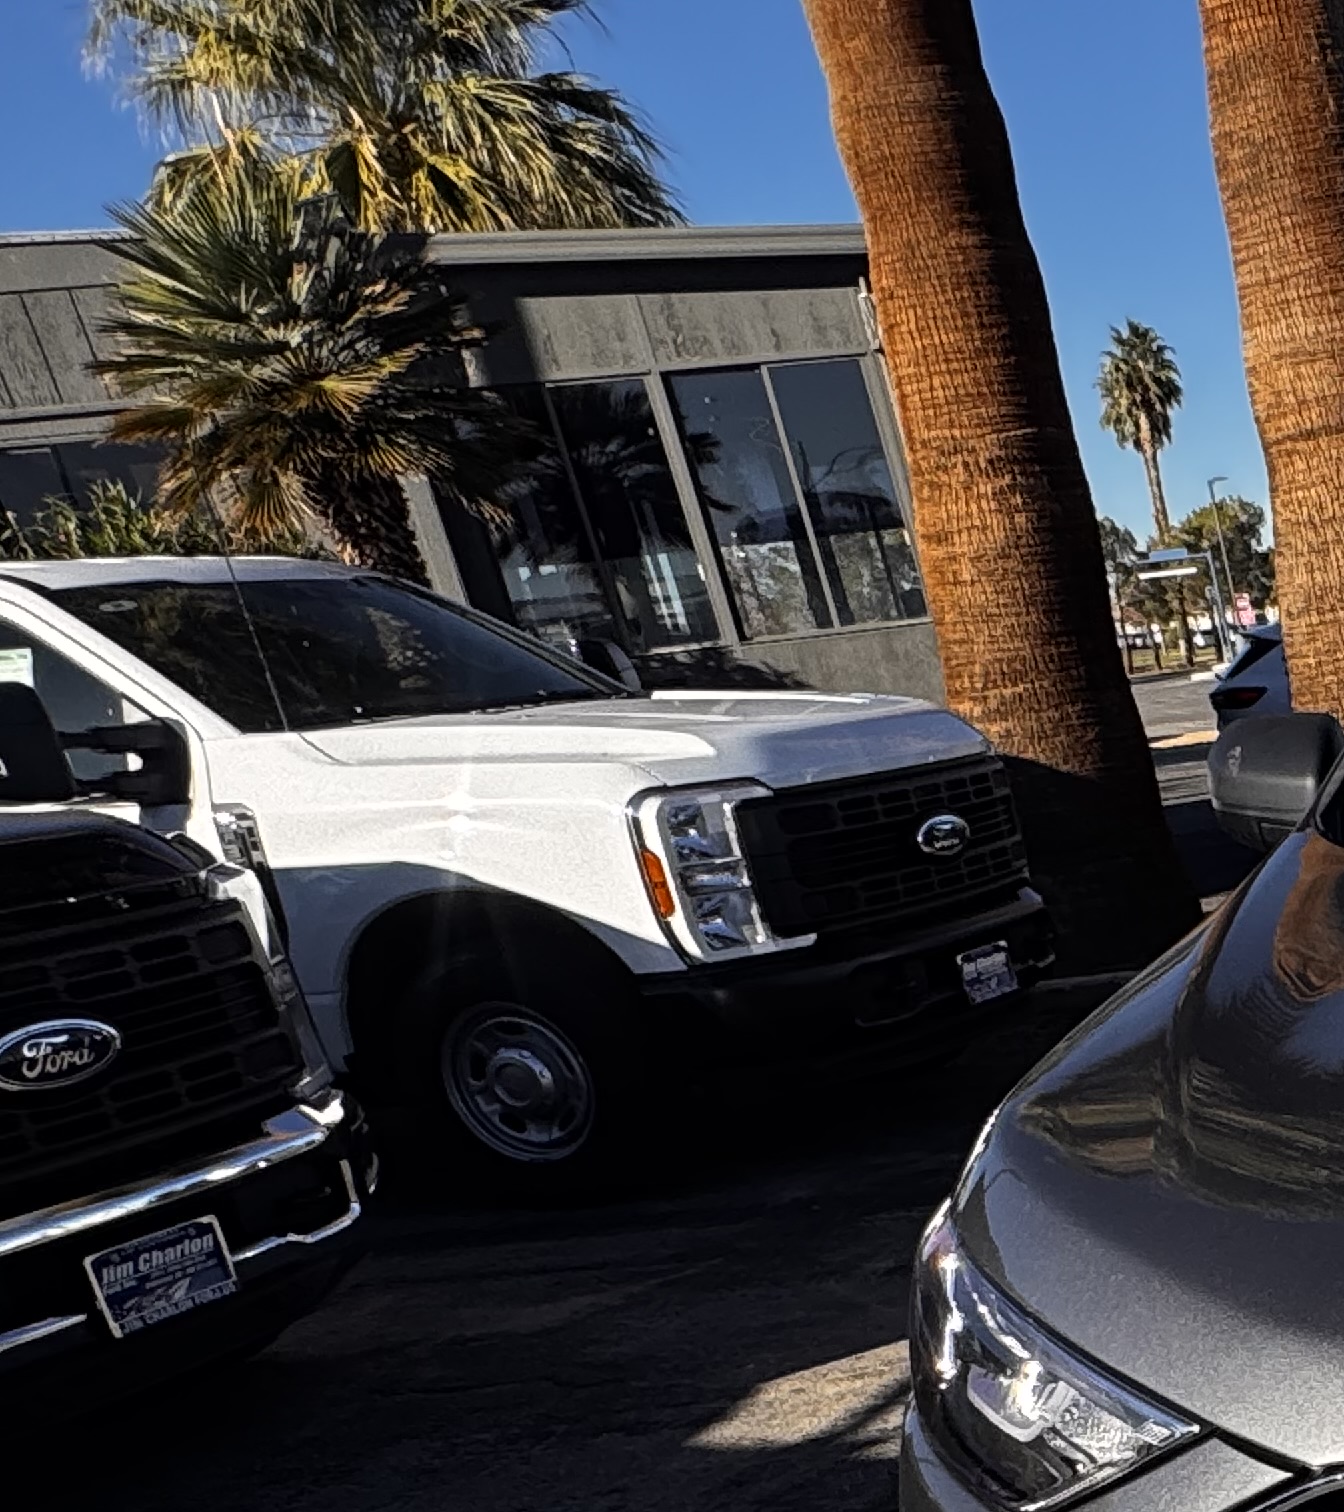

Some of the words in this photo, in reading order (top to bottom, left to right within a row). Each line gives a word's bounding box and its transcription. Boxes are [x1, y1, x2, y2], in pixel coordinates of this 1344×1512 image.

[22, 1034, 96, 1079] Ford
[102, 1260, 134, 1284] Jim
[138, 1233, 214, 1273] Charlon
